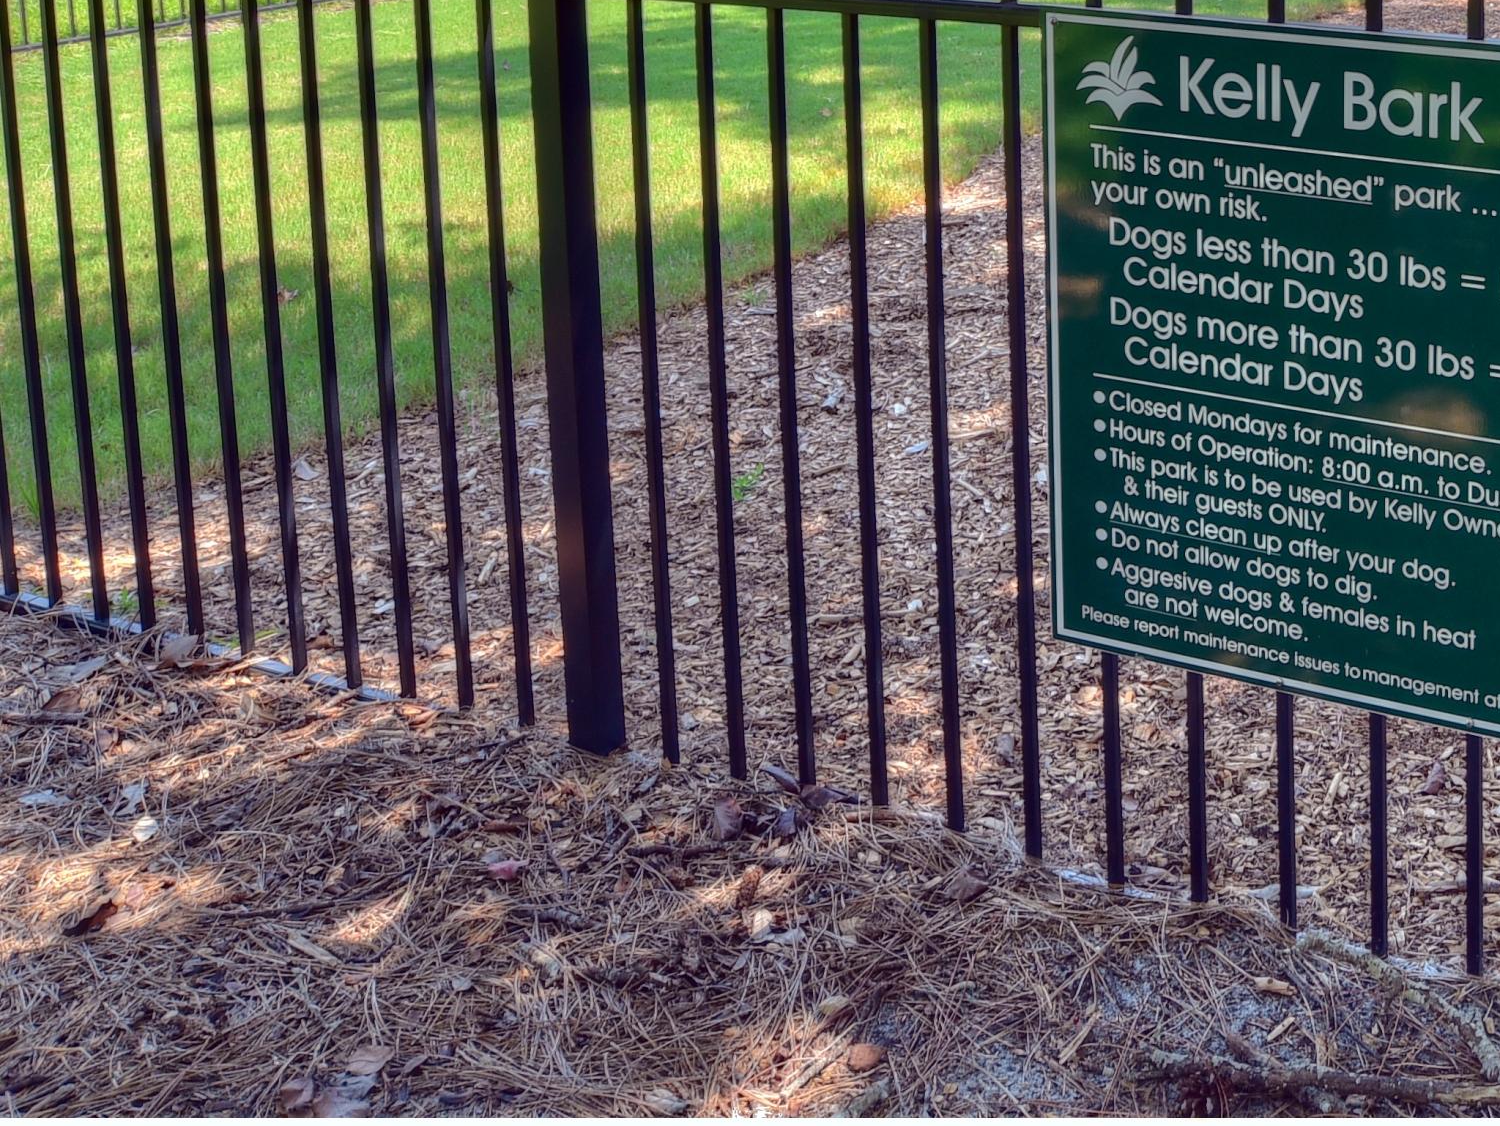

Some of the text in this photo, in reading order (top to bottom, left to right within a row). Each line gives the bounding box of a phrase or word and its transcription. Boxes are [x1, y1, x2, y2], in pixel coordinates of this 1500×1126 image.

[1180, 56, 1320, 137] Kelly
[1344, 72, 1484, 143] Bark
[1091, 144, 1135, 172] This
[1144, 150, 1160, 175] is
[1169, 159, 1203, 180] an
[1395, 185, 1460, 211] park
[1092, 181, 1266, 221] your own risk.
[1109, 217, 1186, 259] Dogs
[1197, 229, 1251, 263] less
[1261, 238, 1334, 275] than
[1347, 249, 1387, 282] 30
[1401, 256, 1445, 290] lbs
[1461, 275, 1485, 289] =
[1124, 257, 1363, 321] Calendar Days
[1111, 297, 1186, 339] Dogs
[1198, 317, 1278, 349] more
[1289, 324, 1362, 362] than
[1375, 337, 1415, 370] 30
[1429, 345, 1474, 379] lbs
[1125, 337, 1362, 404] Calendar Days
[1110, 391, 1491, 474] Closed Mondays for maintenance.
[1110, 419, 1165, 446] Hours
[1171, 433, 1191, 451] of
[1198, 435, 1312, 474] Operation:
[1322, 457, 1370, 483] 8:00
[1378, 471, 1428, 494] a.m.
[1437, 476, 1460, 499] to
[1110, 448, 1144, 472] This
[1152, 460, 1197, 482] park
[1205, 465, 1218, 486] is
[1224, 469, 1245, 490] to
[1252, 474, 1281, 497] be
[1289, 485, 1341, 509] used
[1349, 491, 1377, 519] by
[1385, 498, 1436, 530] Kelly
[1124, 476, 1326, 532] & their guests ONLY.
[1111, 502, 1455, 589] Always clean up after your dog.
[1112, 528, 1377, 603] Do not allow dogs to dig.
[1111, 558, 1476, 649] Aggresive dogs & females in heat
[1125, 589, 1307, 641] are not welcome.
[1082, 605, 1129, 628] Please
[1135, 620, 1179, 639] report
[1184, 631, 1289, 663] maintenance
[1295, 652, 1339, 674] issues
[1345, 663, 1360, 678] to
[1363, 670, 1478, 703] management
